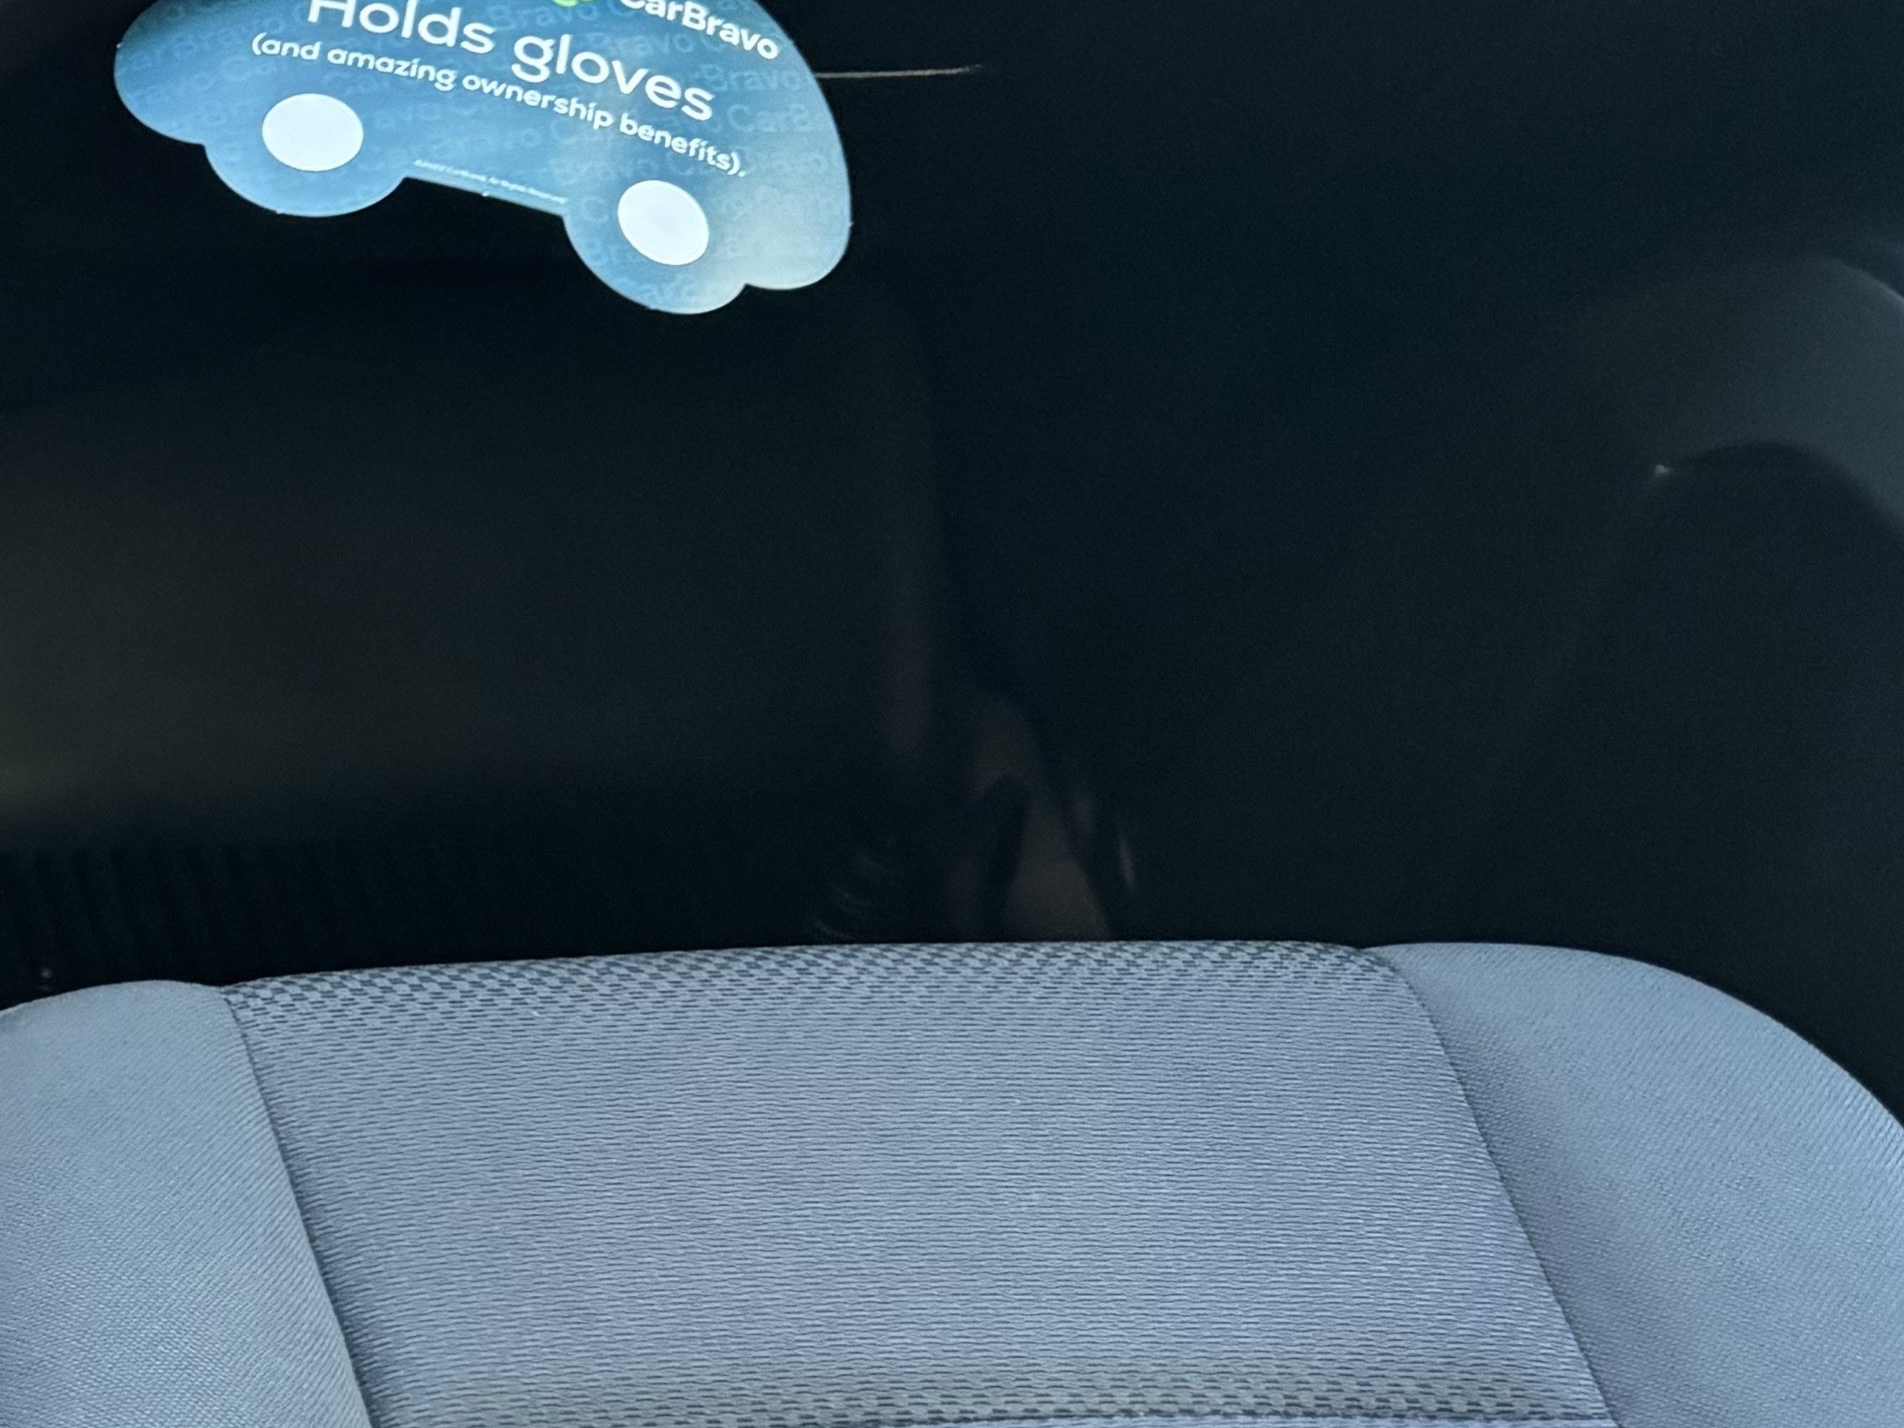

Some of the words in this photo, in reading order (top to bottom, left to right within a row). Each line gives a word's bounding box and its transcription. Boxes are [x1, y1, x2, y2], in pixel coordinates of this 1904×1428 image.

[251, 32, 322, 61] (and
[327, 48, 460, 92] amazing
[461, 74, 615, 131] ownership
[618, 113, 748, 178] benefits).
[511, 33, 716, 121] gloves
